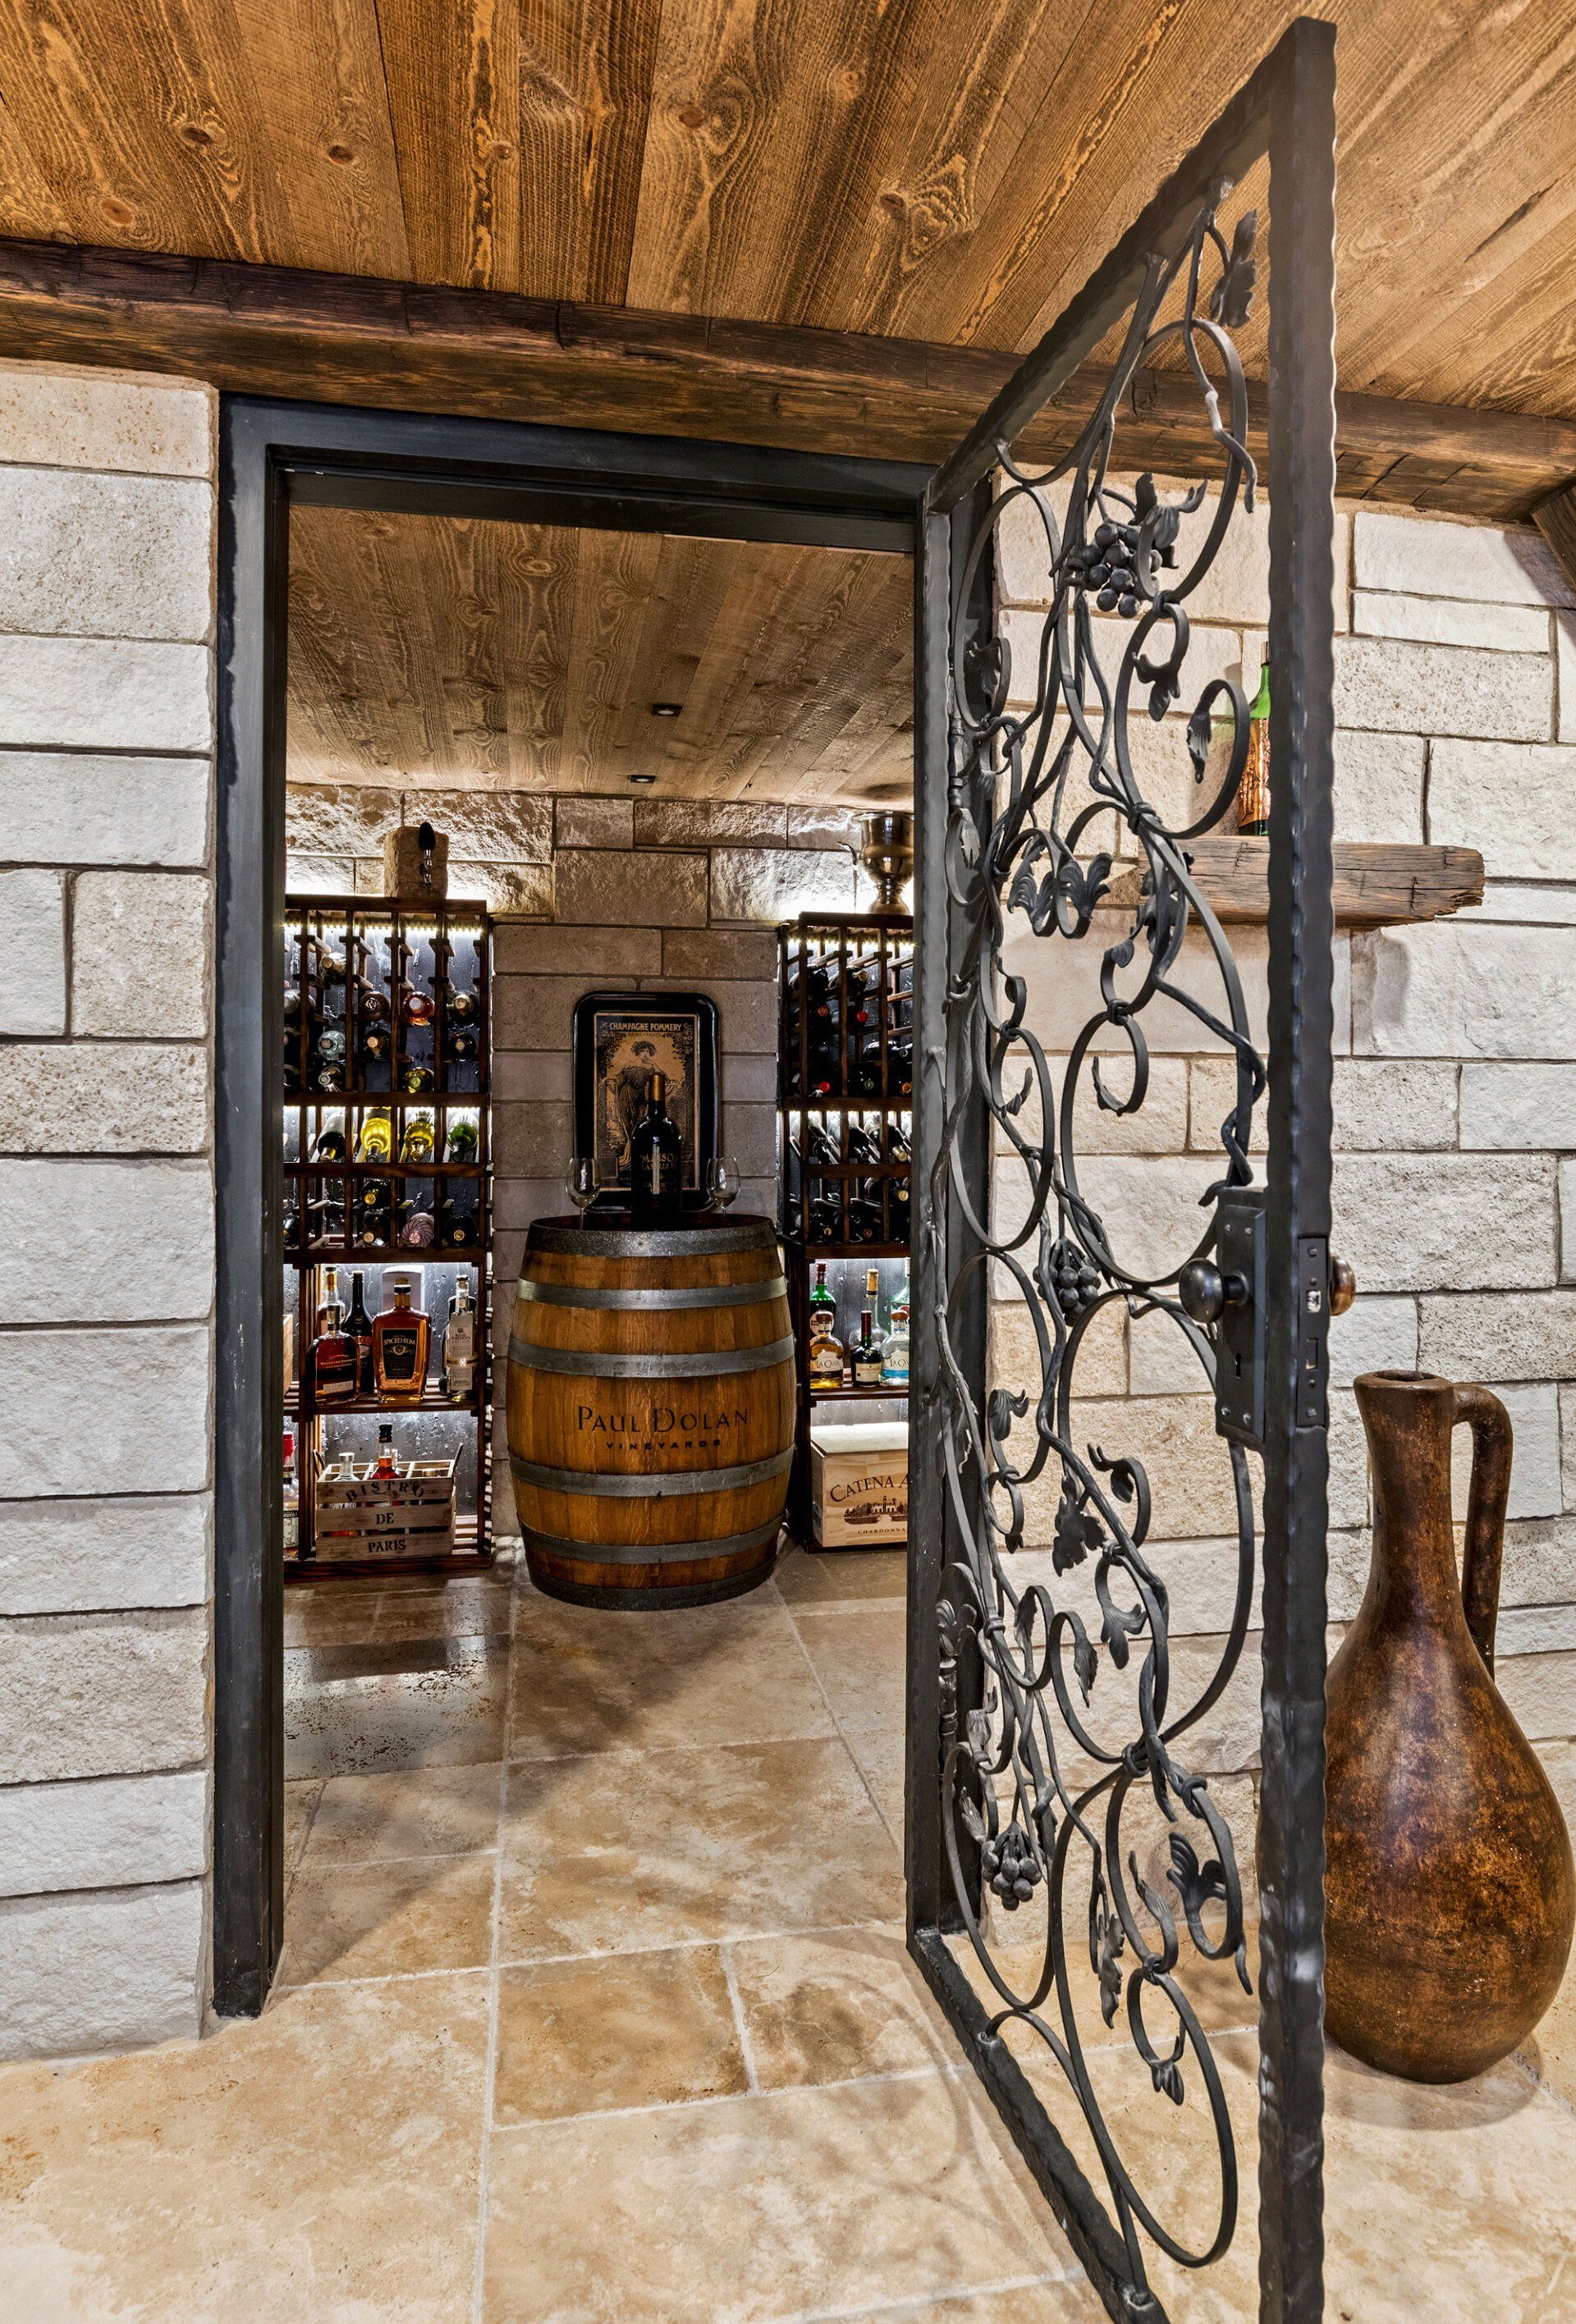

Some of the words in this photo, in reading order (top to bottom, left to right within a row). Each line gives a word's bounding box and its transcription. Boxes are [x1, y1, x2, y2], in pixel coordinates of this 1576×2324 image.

[609, 1022, 649, 1032] CHAMPAGNE
[650, 1022, 682, 1032] POMMERY
[578, 1406, 641, 1432] PAUL
[653, 1407, 748, 1433] DOLAN
[606, 1439, 721, 1450] VINEYARDS
[345, 1480, 425, 1503] BISTRO
[830, 1476, 894, 1502] CATENA
[376, 1512, 395, 1525] DE
[368, 1539, 406, 1553] PARIS
